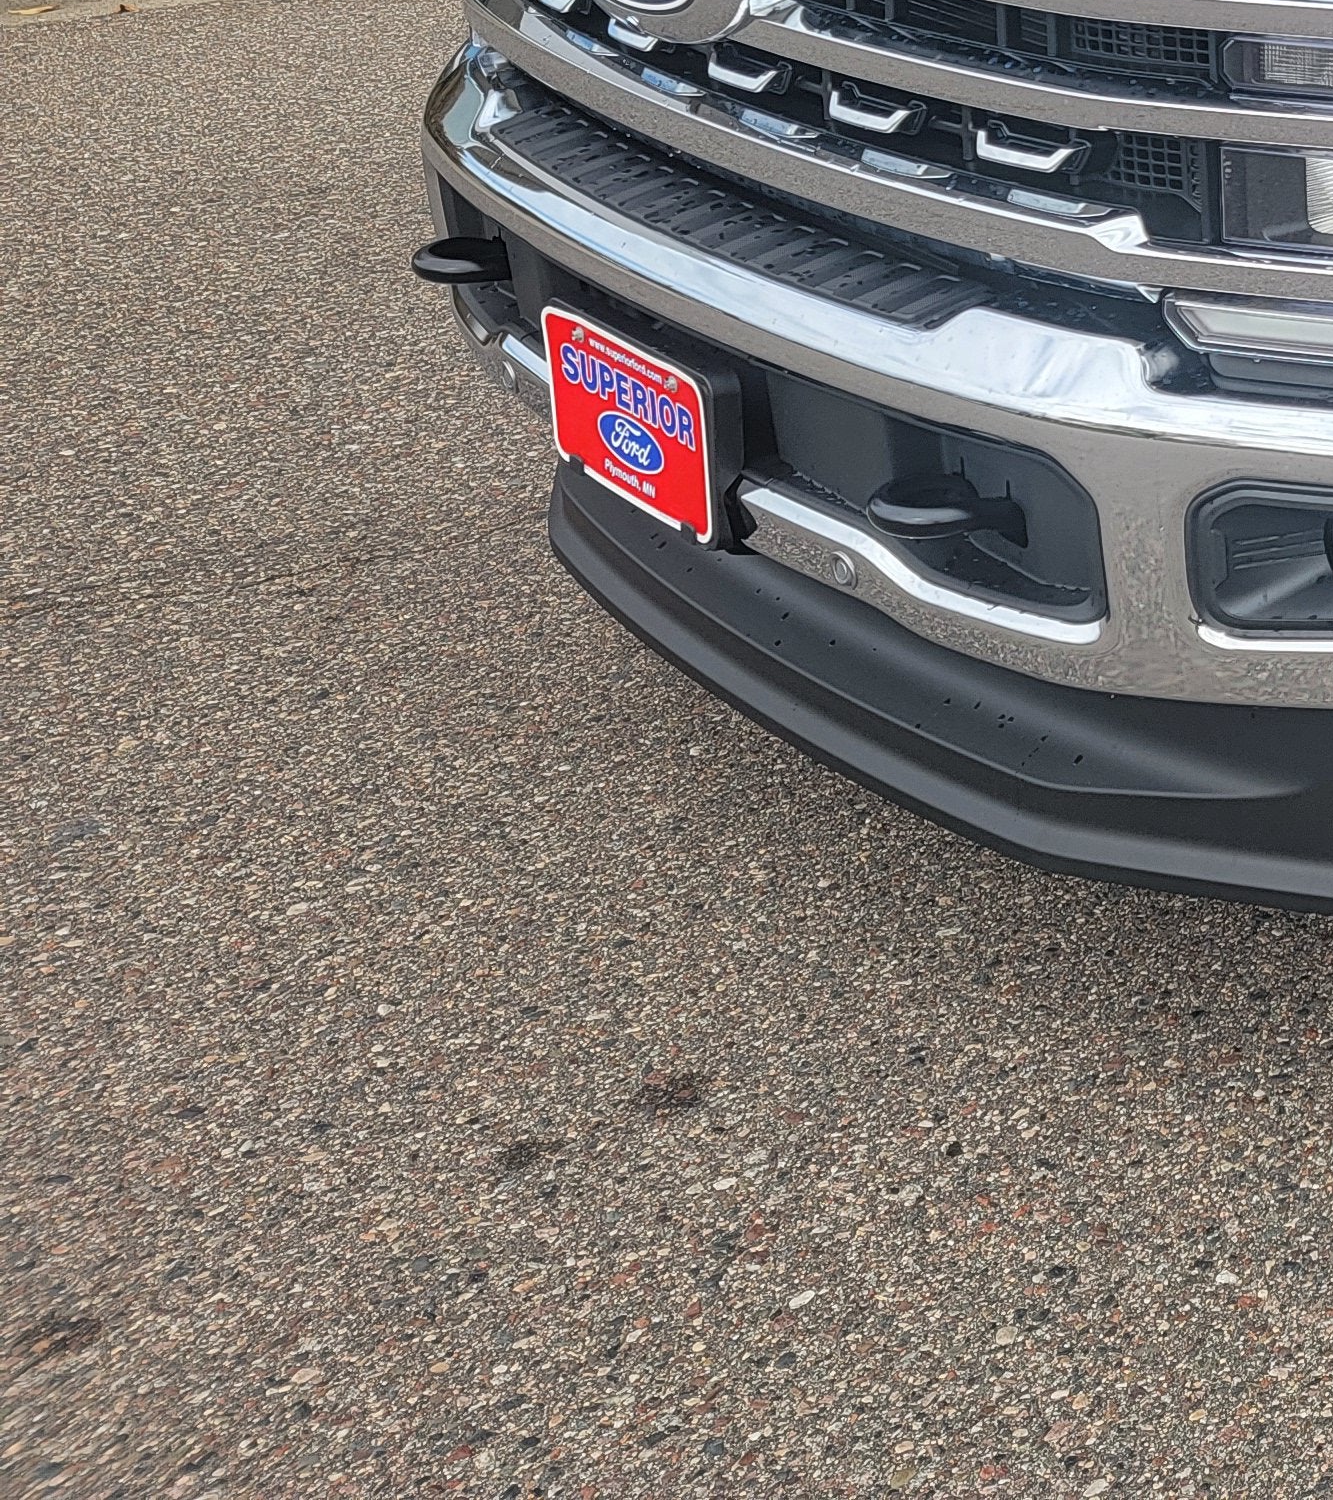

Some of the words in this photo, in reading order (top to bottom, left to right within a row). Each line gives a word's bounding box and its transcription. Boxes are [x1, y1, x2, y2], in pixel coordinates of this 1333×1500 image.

[588, 337, 662, 386] www.superiorford.com
[560, 343, 696, 452] SUPERIOR
[611, 418, 652, 467] Ford
[604, 457, 641, 492] Plymouth,
[642, 482, 656, 499] MN
